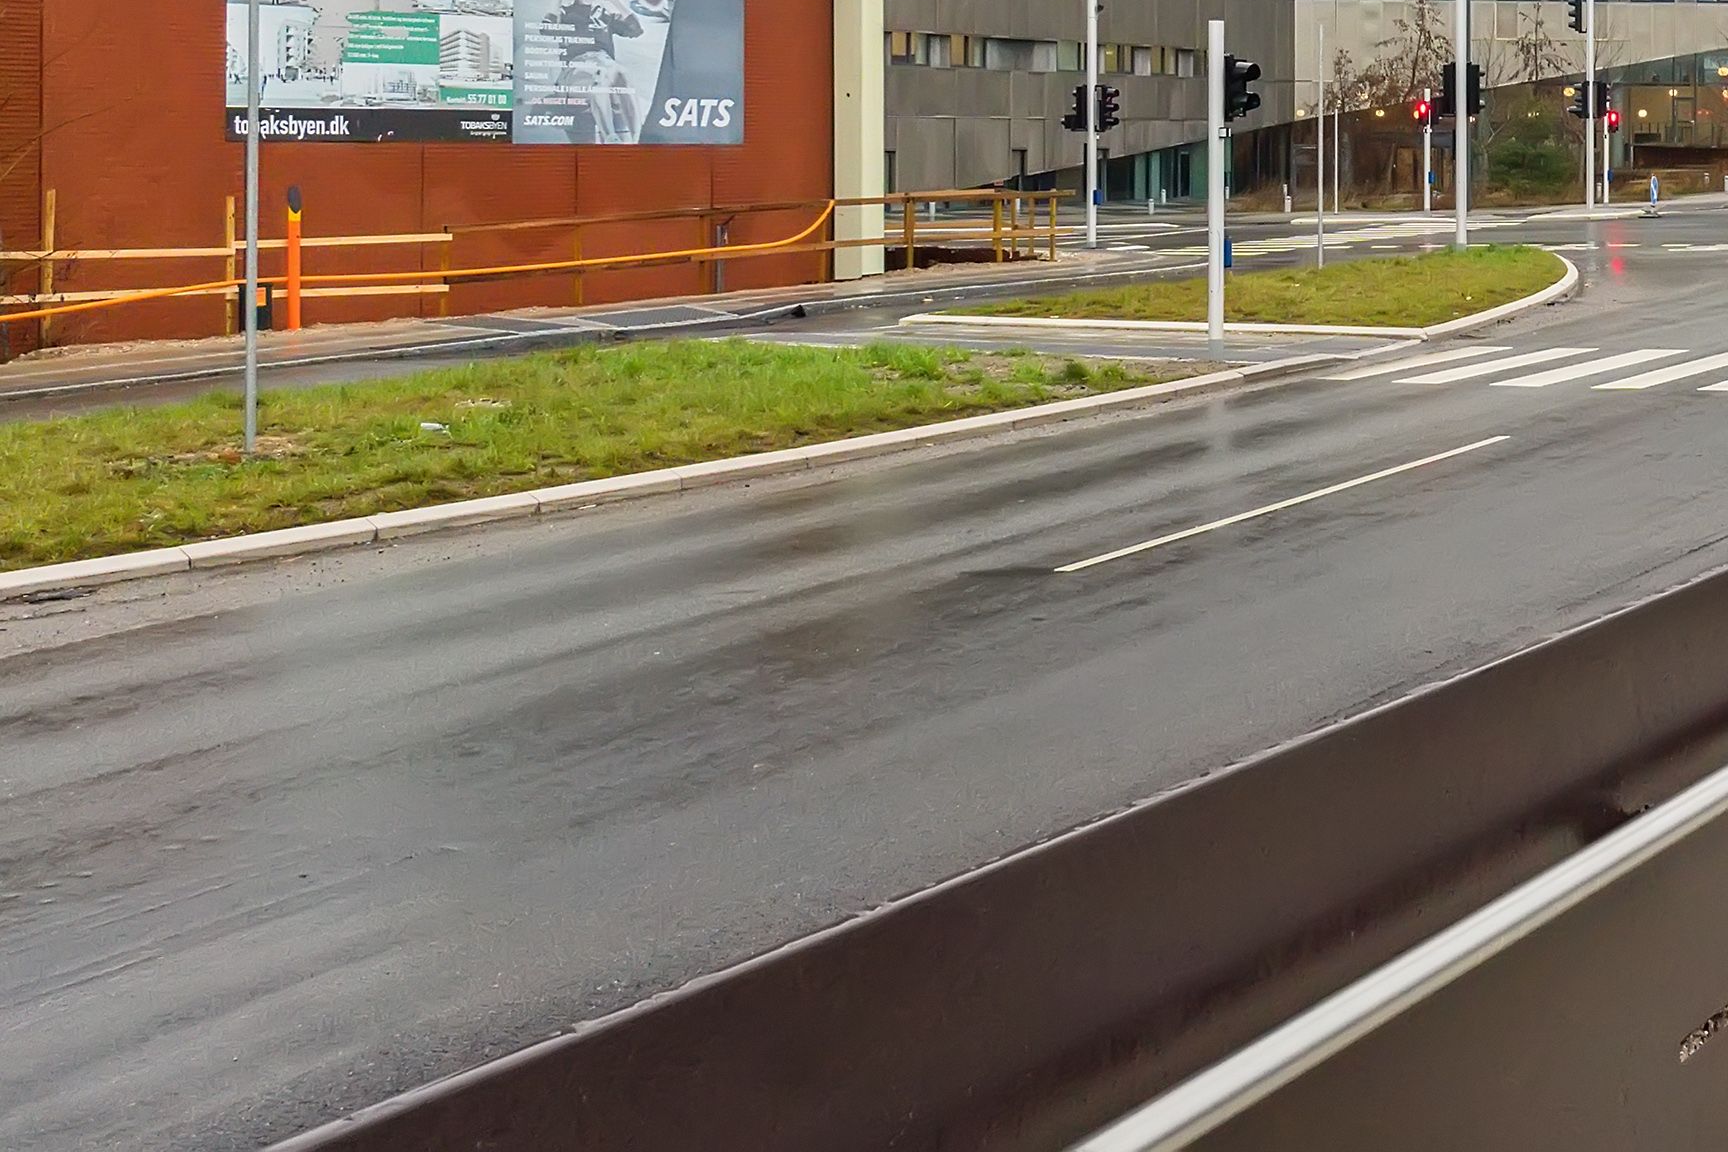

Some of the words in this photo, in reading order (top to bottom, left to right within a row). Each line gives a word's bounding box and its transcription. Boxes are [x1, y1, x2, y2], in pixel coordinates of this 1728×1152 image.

[523, 115, 576, 126] SATS.COM
[658, 97, 735, 128] SATS
[233, 114, 350, 140] toaksbyen.dk
